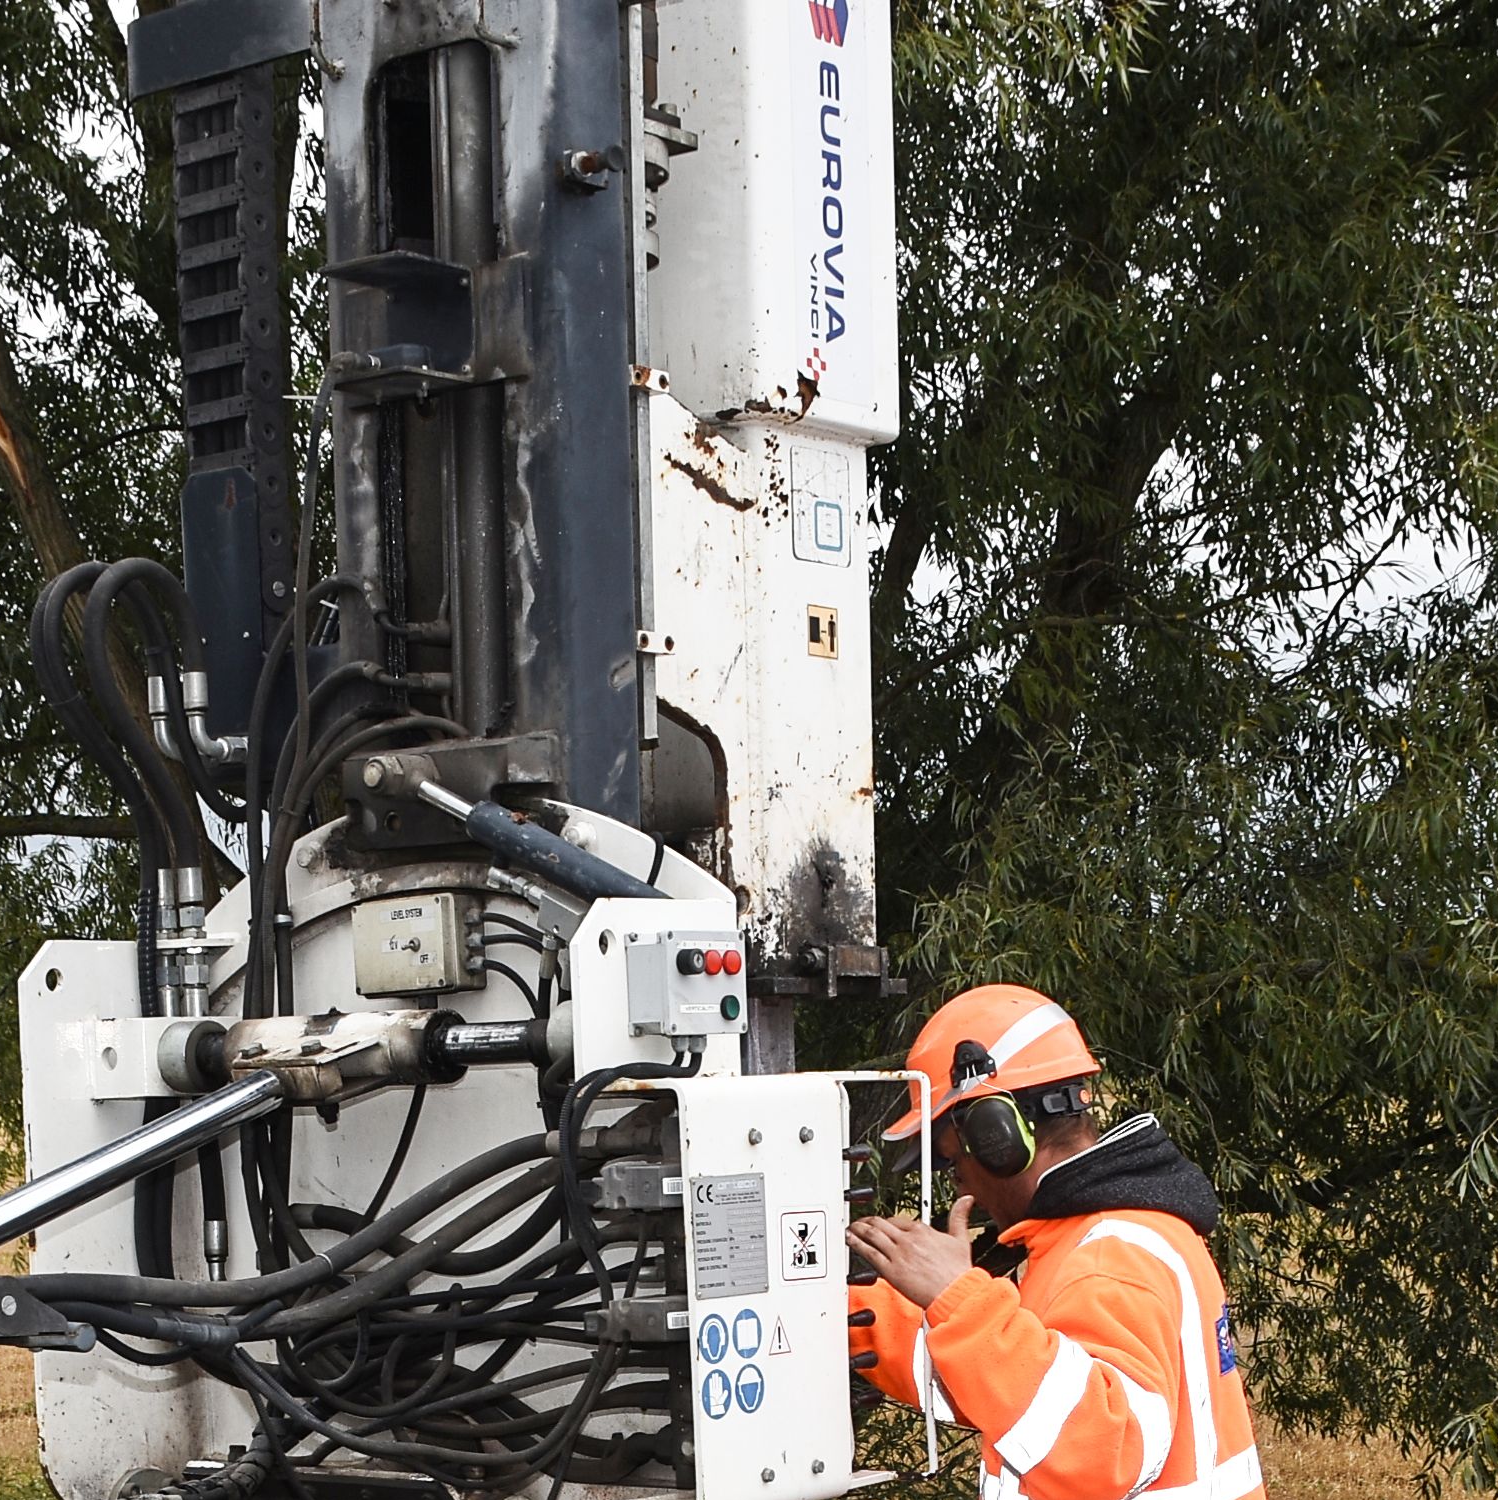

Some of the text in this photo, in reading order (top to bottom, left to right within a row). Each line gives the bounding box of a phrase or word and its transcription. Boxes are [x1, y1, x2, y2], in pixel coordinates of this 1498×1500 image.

[819, 60, 846, 344] EUROVIA
[809, 252, 819, 339] VINCI
[390, 910, 404, 920] LEVEL
[697, 1184, 713, 1203] CE
